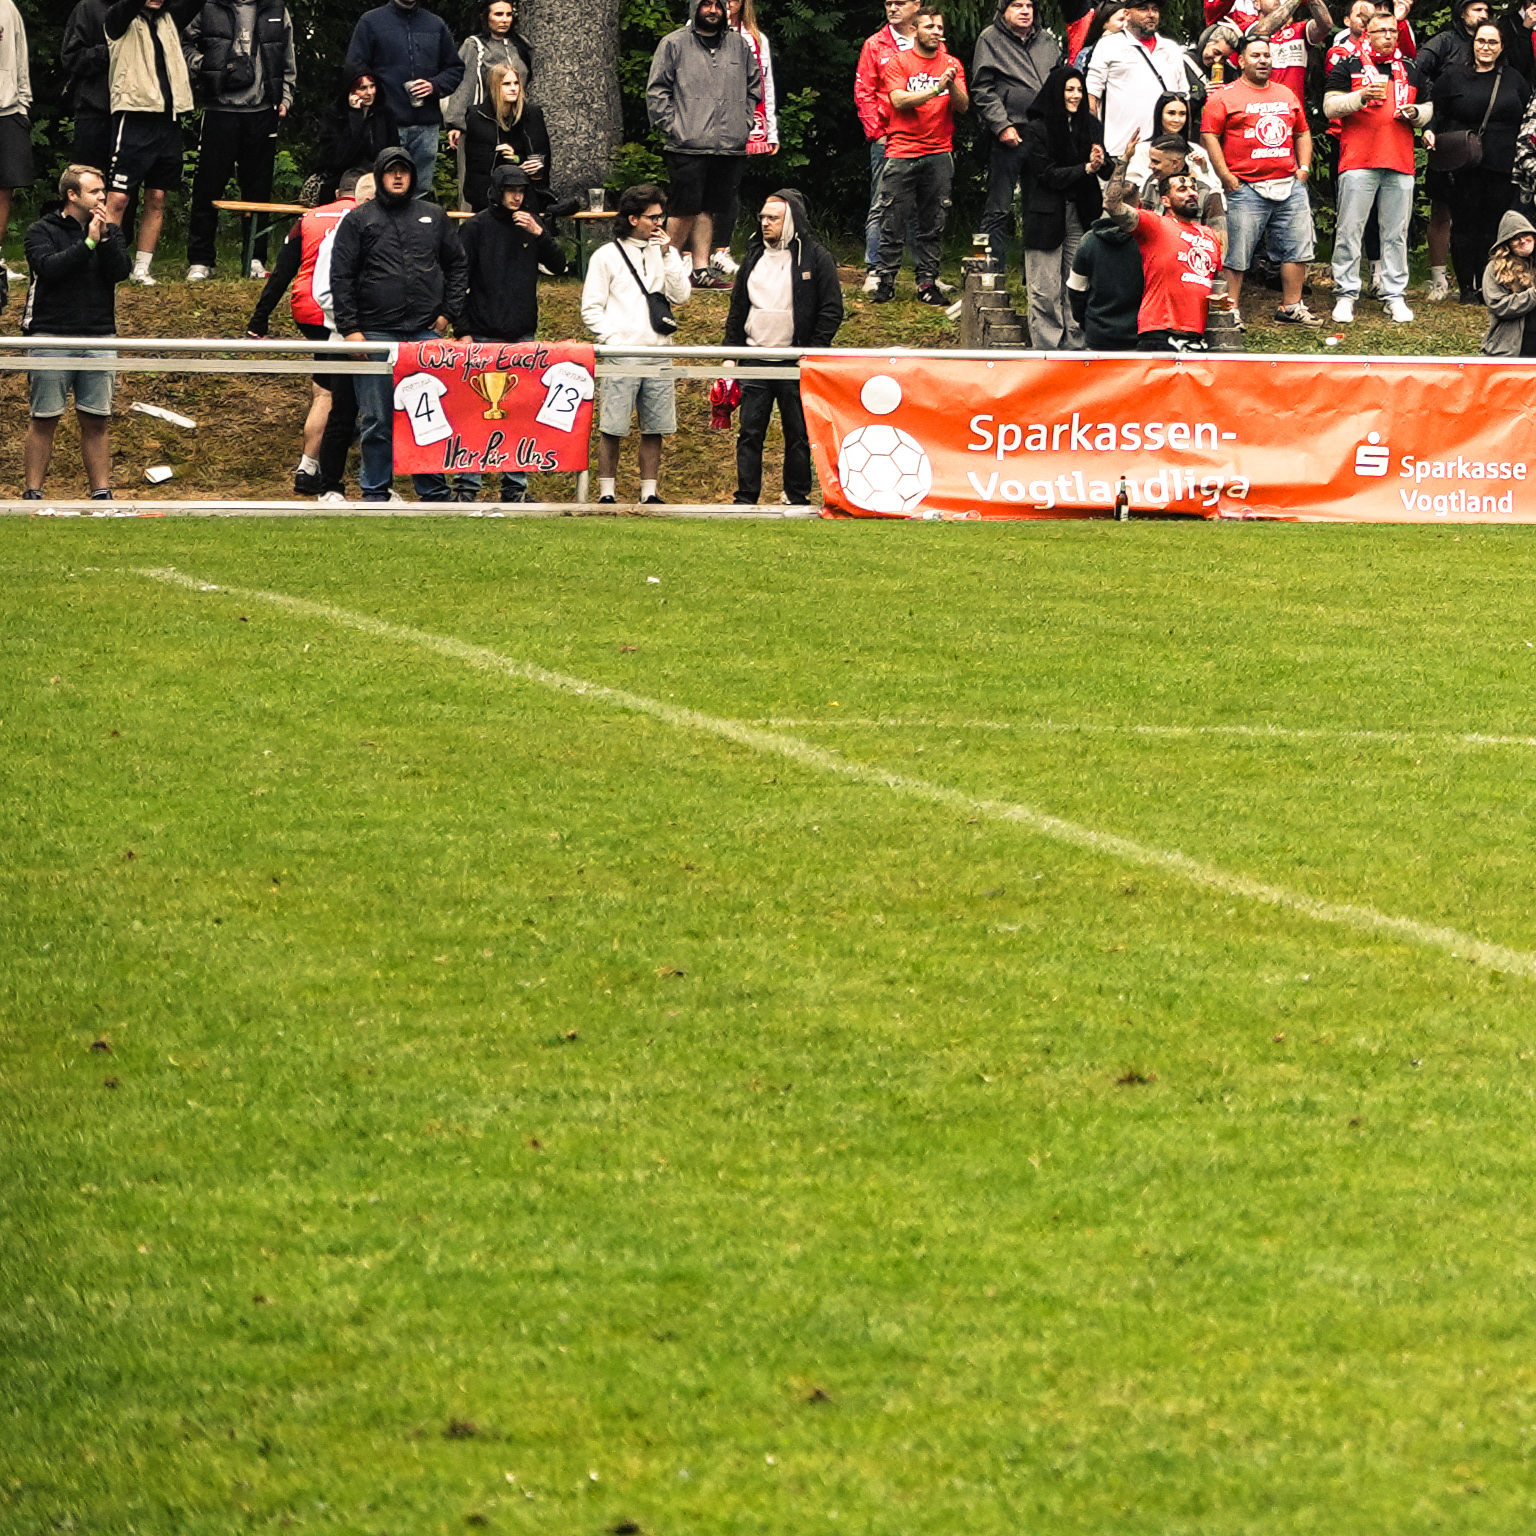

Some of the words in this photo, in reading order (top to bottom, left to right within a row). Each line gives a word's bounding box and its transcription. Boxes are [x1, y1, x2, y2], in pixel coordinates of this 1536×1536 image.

[418, 343, 460, 369] Wir
[463, 343, 493, 381] für
[496, 344, 549, 371] Euch
[415, 391, 435, 423] 4
[547, 383, 579, 413] 13
[443, 434, 480, 470] Ihr
[516, 437, 559, 472] Uns
[967, 412, 1237, 461] Sparkassen-
[1400, 456, 1527, 481] Sparkasse
[966, 467, 1251, 510] Vogtlandliga
[1400, 489, 1513, 517] Vogtland
